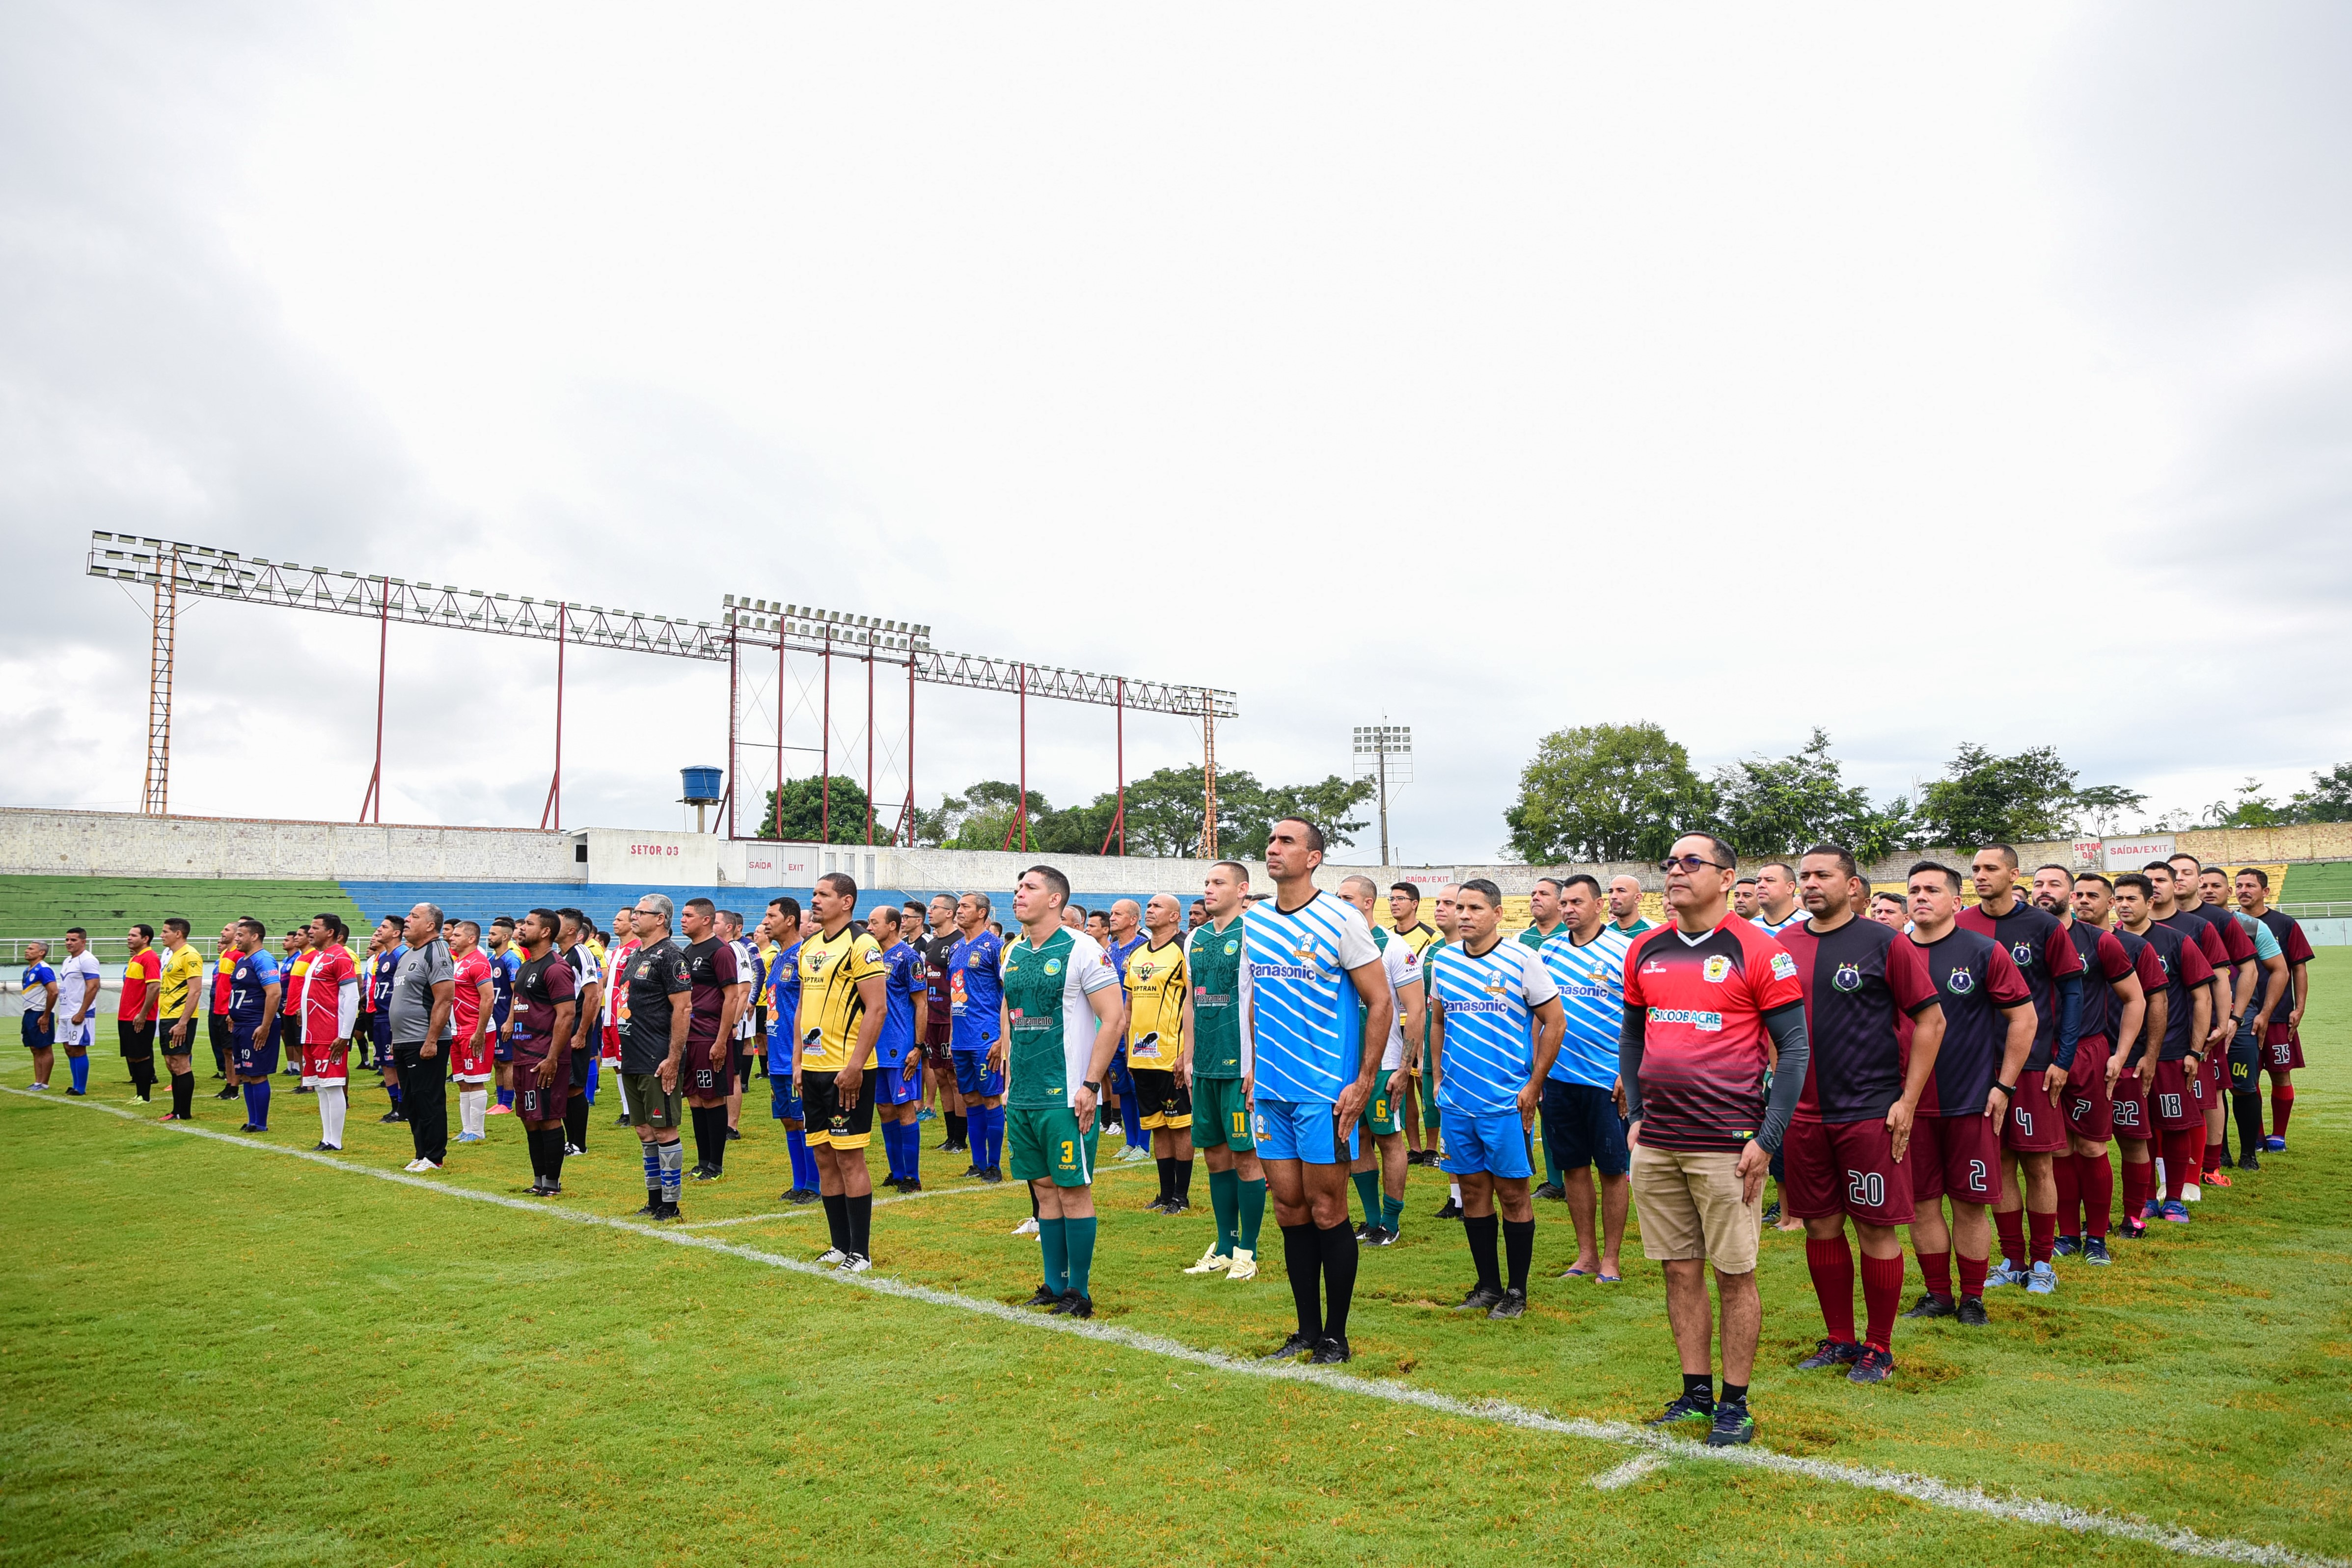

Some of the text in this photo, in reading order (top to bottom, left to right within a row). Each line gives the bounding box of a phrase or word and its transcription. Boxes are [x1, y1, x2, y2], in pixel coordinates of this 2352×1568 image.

[630, 844, 679, 856] SETOR 03
[2074, 842, 2102, 851] SETOR
[2110, 844, 2168, 855] SAÍDA/EXIT
[788, 863, 804, 872] EXIT
[1406, 874, 1449, 883] SAÍDA/EXIT
[1250, 963, 1315, 980] Panasonic
[394, 975, 407, 987] BOPE
[374, 982, 390, 1000] 07
[1558, 985, 1608, 997] nasonic
[228, 989, 246, 1009] 07
[1444, 999, 1507, 1012] Panasonic
[1655, 1011, 1721, 1024] SICOOB ACRE
[69, 1030, 78, 1041] 18
[241, 1049, 250, 1060] 19
[385, 1044, 391, 1054] 3
[315, 1059, 329, 1073] 27
[464, 1058, 473, 1070] 16
[980, 1063, 987, 1076] 2
[2232, 1062, 2247, 1078] 04
[697, 1070, 712, 1088] 22
[1376, 1100, 1386, 1118] 6
[2073, 1099, 2091, 1121] 7
[2160, 1094, 2182, 1118] 18
[2112, 1101, 2139, 1126] 22
[1232, 1112, 1245, 1132] 11
[2016, 1107, 2033, 1135] 4
[1061, 1141, 1073, 1163] 3
[1969, 1159, 1987, 1191] 2
[1848, 1169, 1884, 1207] 20
